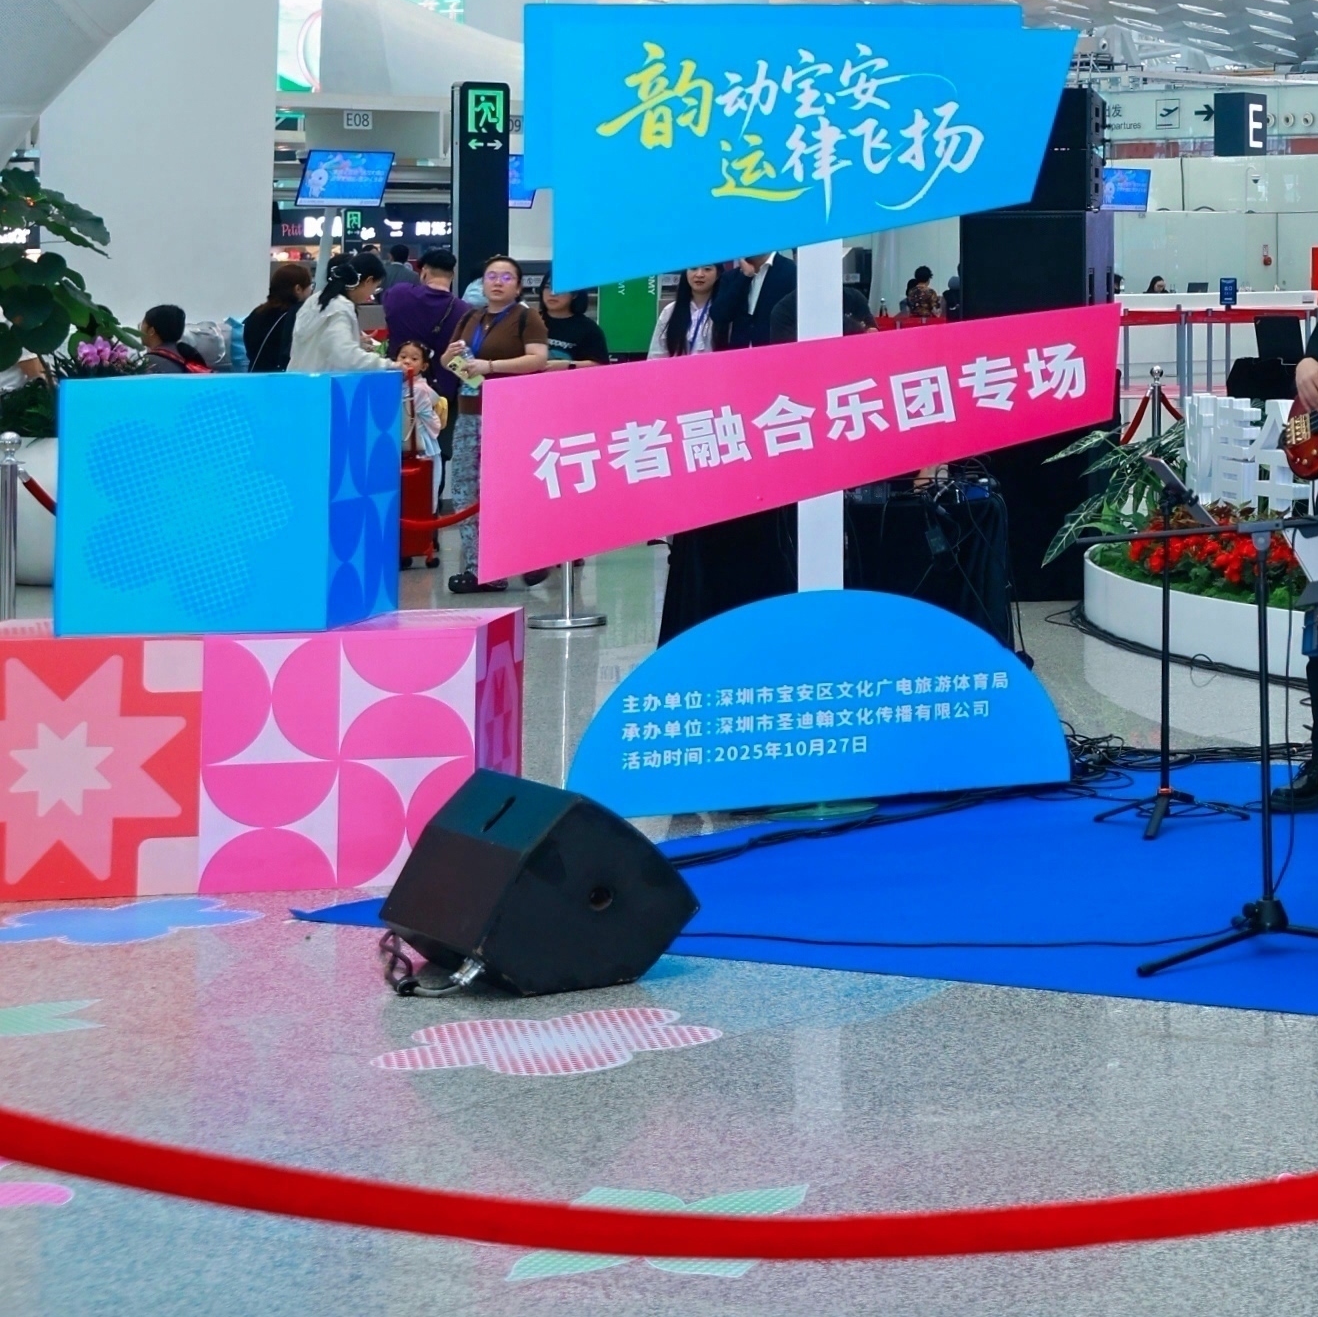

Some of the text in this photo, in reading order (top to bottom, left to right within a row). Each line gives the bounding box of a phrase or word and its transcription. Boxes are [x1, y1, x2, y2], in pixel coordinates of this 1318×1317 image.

[597, 42, 940, 149] 韵动宝安
[346, 113, 370, 127] E08
[508, 118, 521, 132] 09
[1248, 103, 1263, 149] E
[712, 99, 984, 223] 运律飞扬
[530, 342, 1088, 500] 行者融合乐团专场
[622, 671, 1009, 714] 主办单位：深圳市宝安区文化广电旅游体育局
[621, 700, 990, 742] 承办单位：深圳市圣迪翰文化传播有限公司
[621, 736, 868, 771] 活动时间：2025年10月27日
